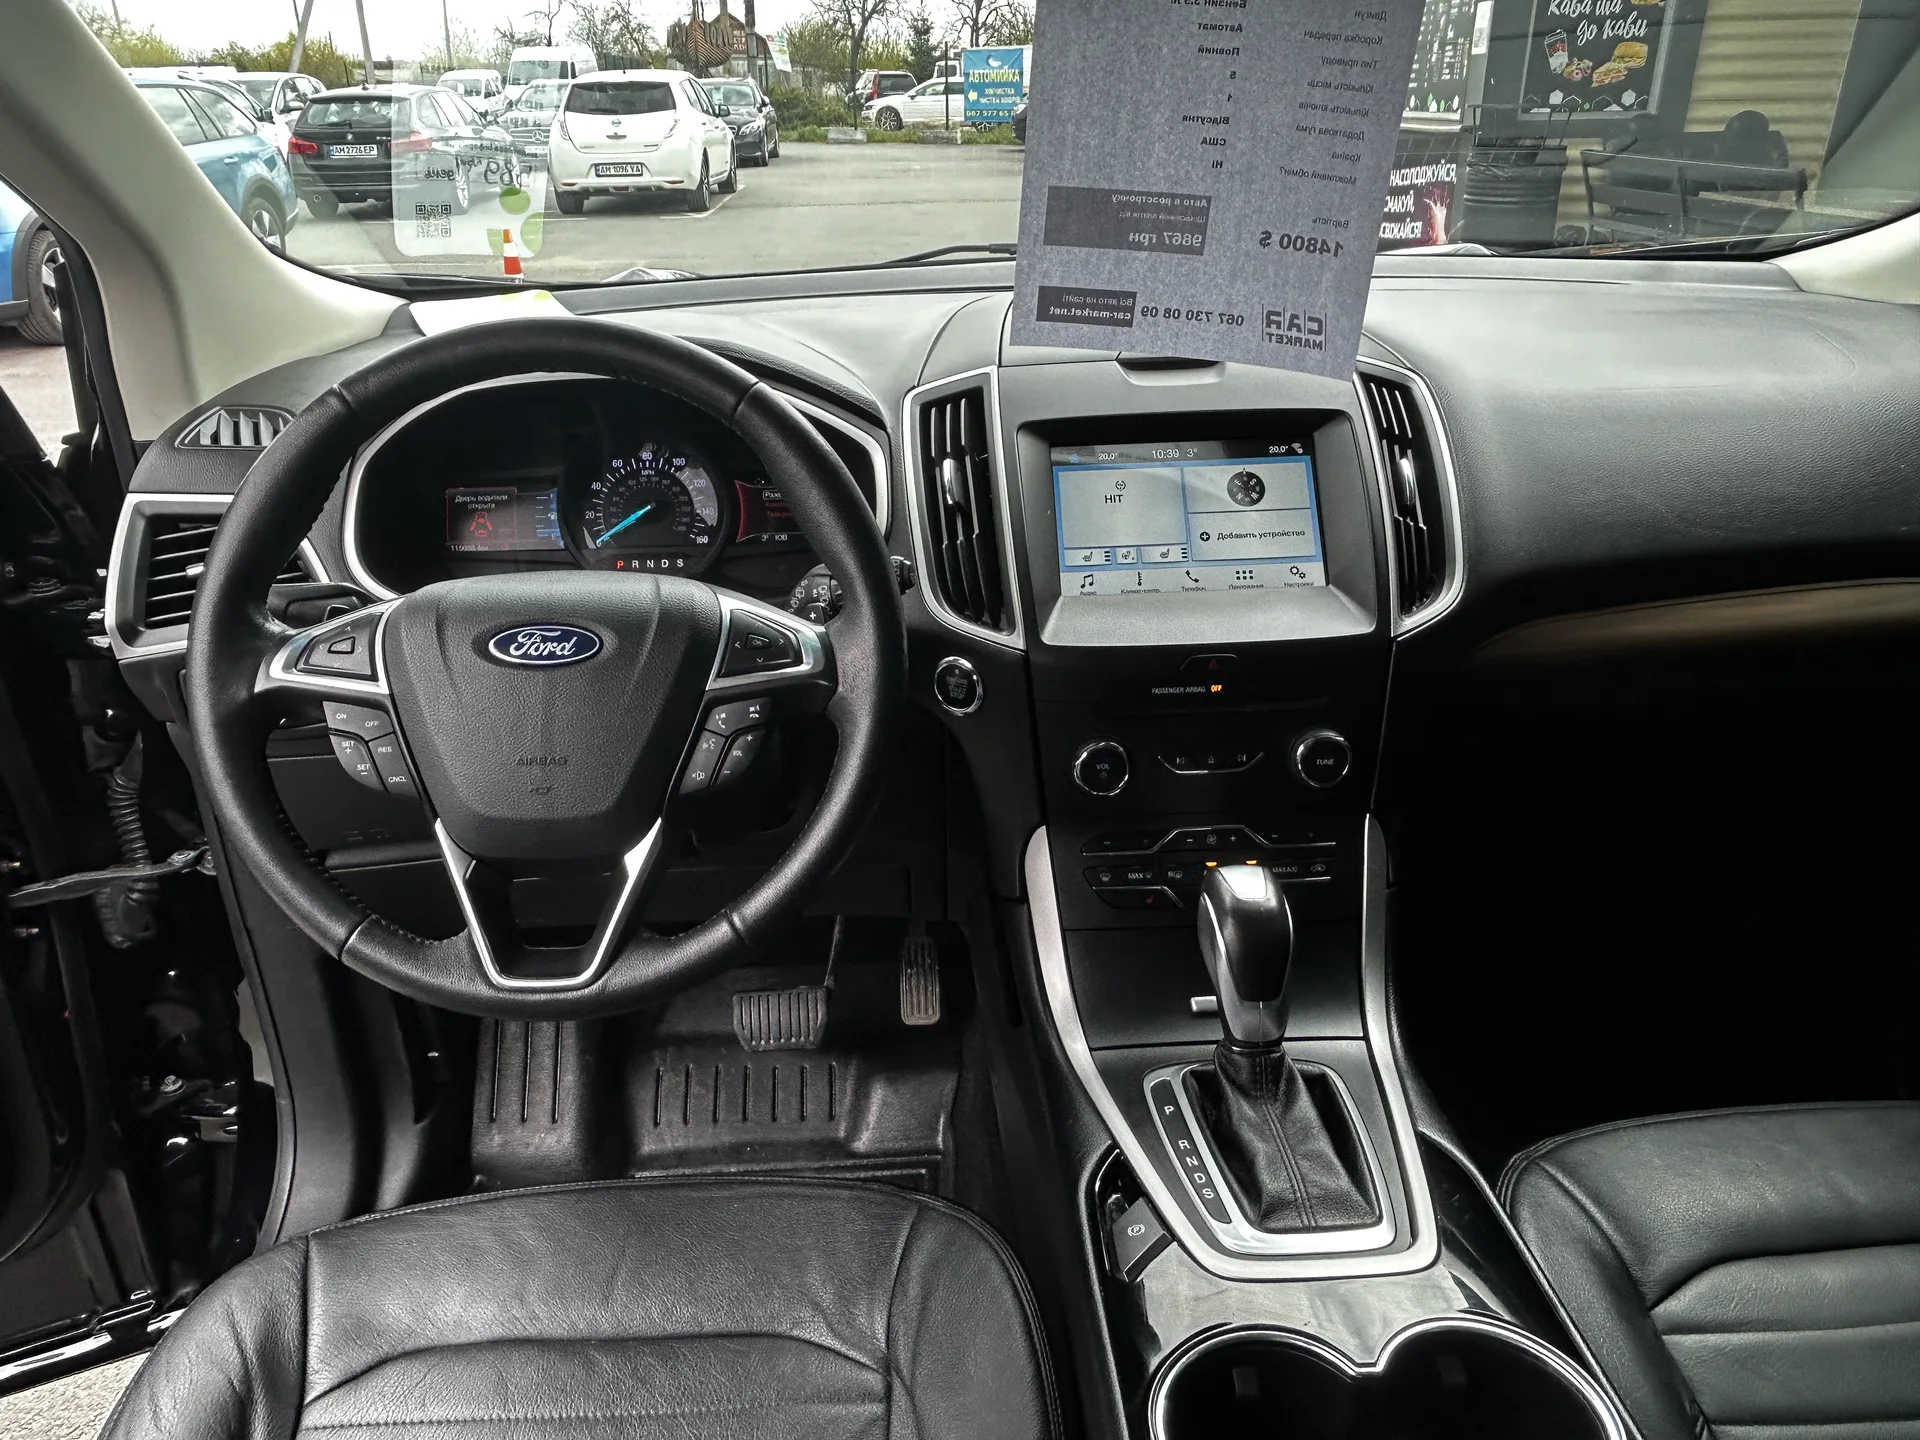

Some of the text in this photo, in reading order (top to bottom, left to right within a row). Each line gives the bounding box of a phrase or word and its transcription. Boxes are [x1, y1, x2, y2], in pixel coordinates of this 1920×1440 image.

[1548, 0, 1593, 18] Кава
[1577, 10, 1649, 46] до кави
[969, 66, 1019, 82] АВТОМИЙКА
[1379, 218, 1423, 239] СВІЖАЙСЯ!
[1151, 450, 1180, 460] 10:39
[612, 459, 623, 468] 60
[672, 458, 686, 466] 100
[591, 482, 602, 490] 40
[693, 479, 706, 487] 120
[1104, 494, 1124, 504] HIT
[585, 511, 595, 519] 20
[702, 508, 714, 516] 140
[696, 535, 708, 544] 160
[1217, 530, 1306, 541] Добавить устройство
[617, 558, 684, 569] P R N D S
[509, 629, 578, 656] Ford
[1210, 684, 1222, 692] OFF
[516, 755, 568, 766] AIRBAG
[1316, 758, 1334, 766] TUNE
[1127, 872, 1144, 880] MAX
[1164, 1106, 1174, 1115] P
[1178, 1140, 1190, 1150] R
[1186, 1156, 1198, 1167] N
[1194, 1173, 1206, 1184] D
[1202, 1188, 1214, 1199] S
